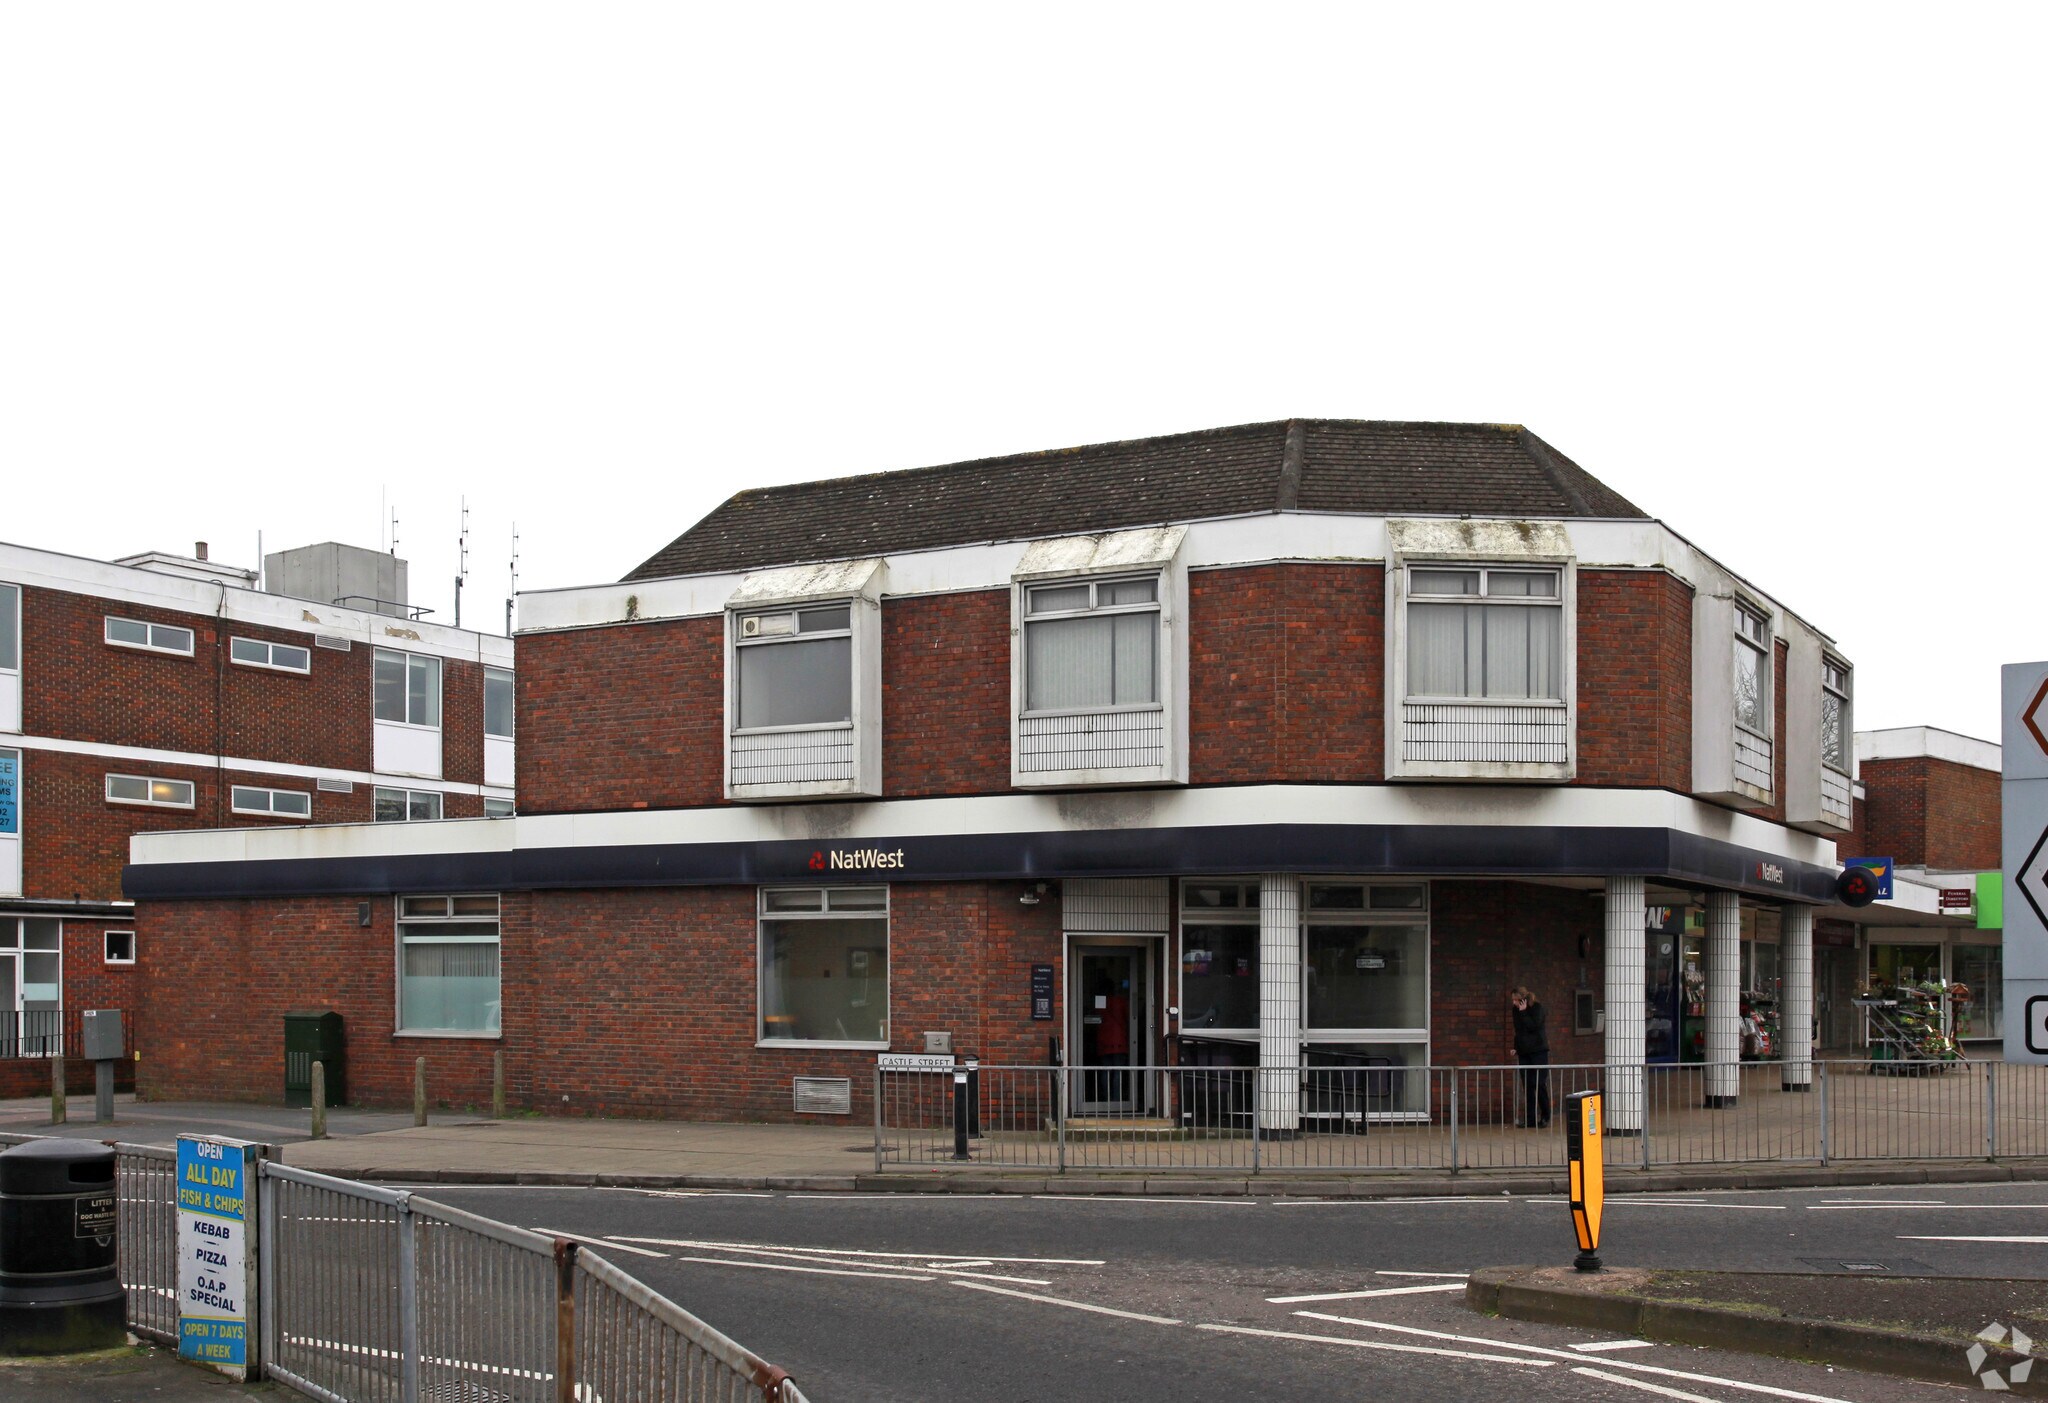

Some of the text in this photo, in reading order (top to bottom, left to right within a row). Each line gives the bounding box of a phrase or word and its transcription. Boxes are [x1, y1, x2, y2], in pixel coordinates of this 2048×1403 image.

[830, 848, 905, 869] NatWest
[1762, 862, 1784, 884] NatWest
[918, 1058, 950, 1066] STREET
[197, 1142, 223, 1160] OPEN
[186, 1163, 237, 1189] ALL DAY
[180, 1188, 245, 1215] FISH & CHIPS
[193, 1220, 230, 1239] KEBAB
[196, 1248, 227, 1267] PIZZA
[197, 1276, 227, 1293] O.A.P
[190, 1288, 236, 1312] SPECIAL
[184, 1323, 244, 1339] OPEN 7 DAYS
[196, 1343, 231, 1358] A WEEK
